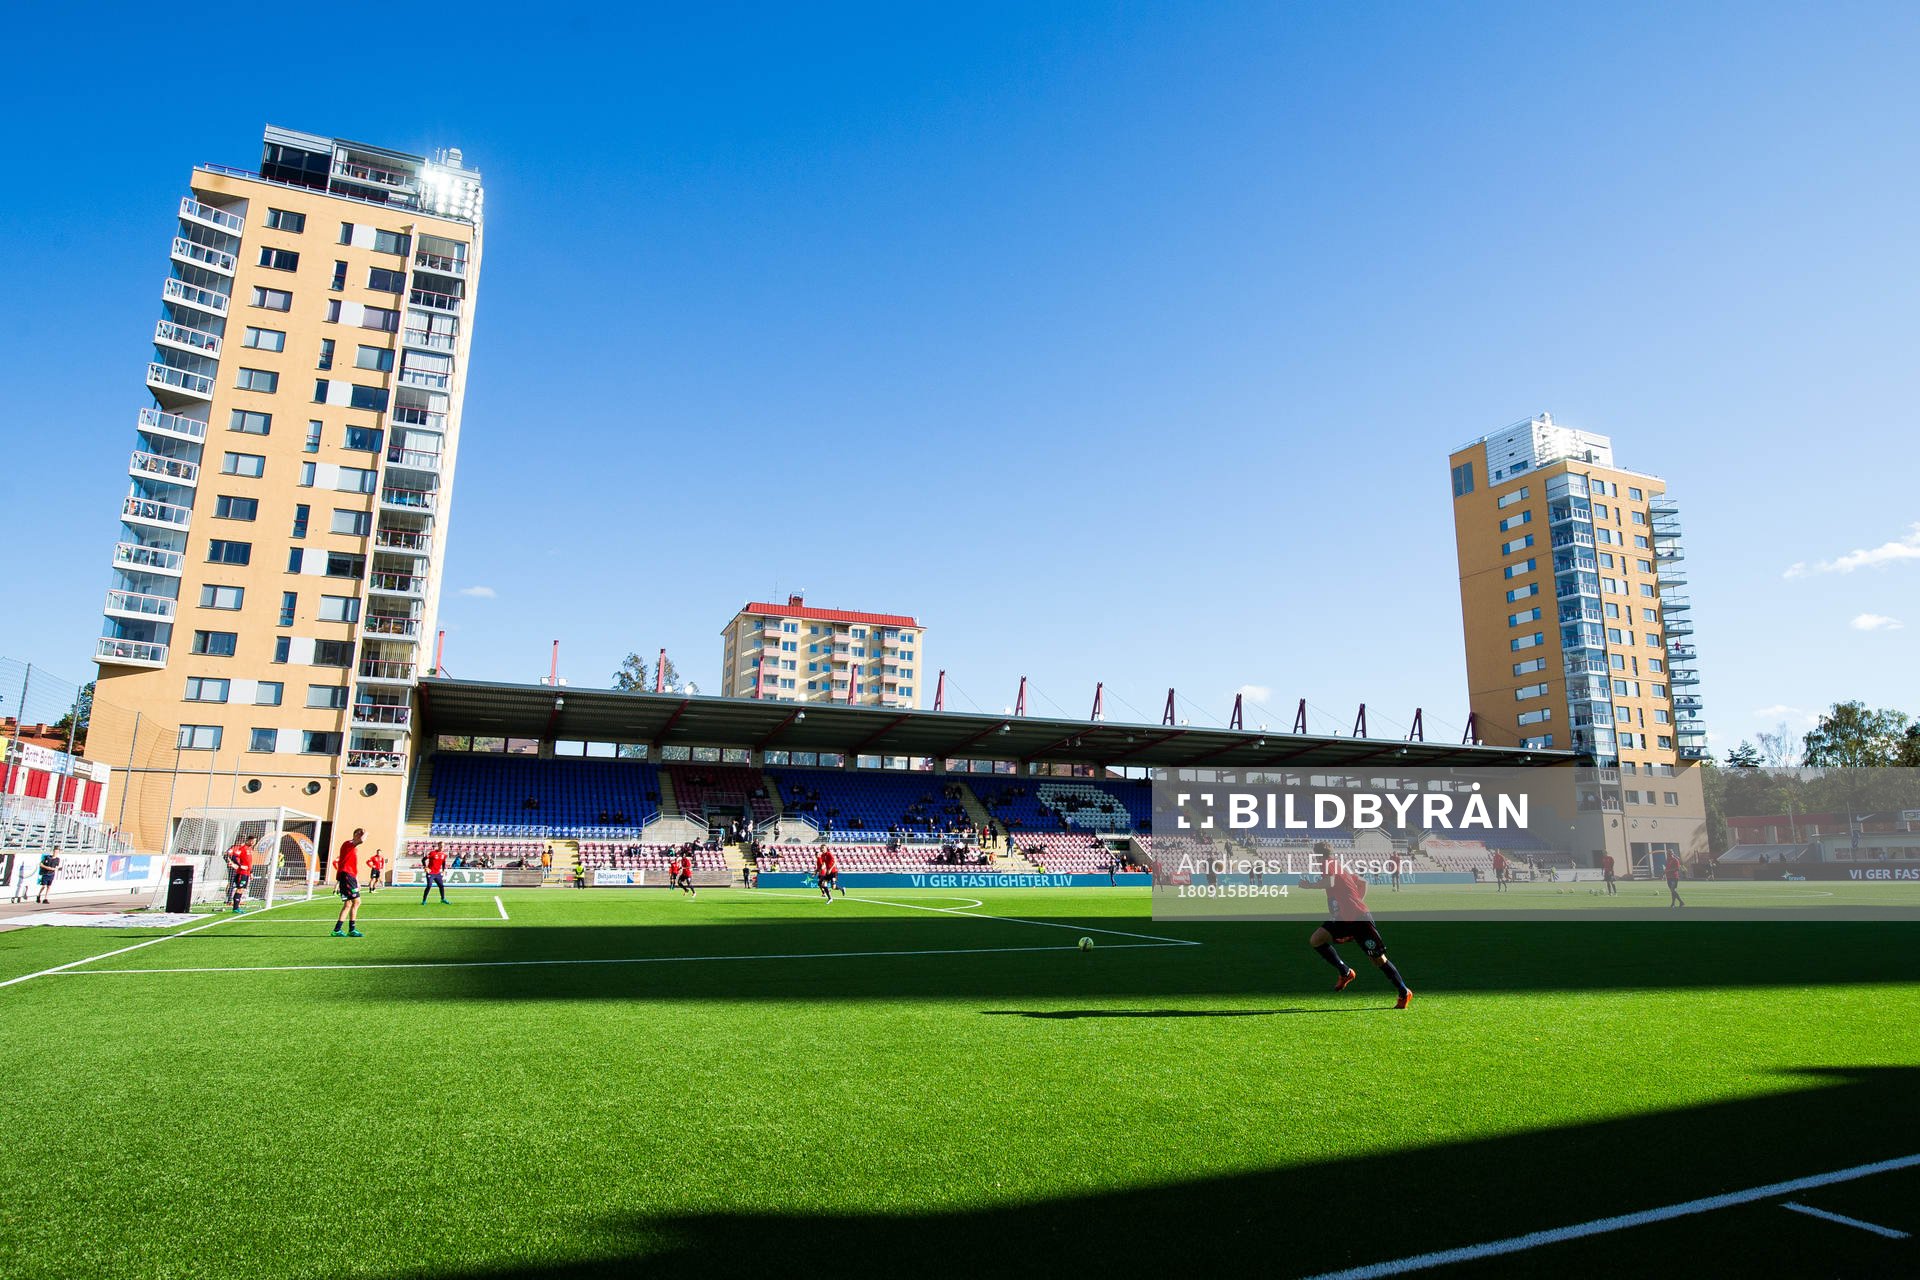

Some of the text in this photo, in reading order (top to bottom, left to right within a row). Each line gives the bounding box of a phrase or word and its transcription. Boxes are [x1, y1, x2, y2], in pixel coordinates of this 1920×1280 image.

[1849, 869, 1862, 880] VI
[1865, 868, 1891, 880] GER
[911, 874, 1073, 887] VI GER FASTIGHETER LIV
